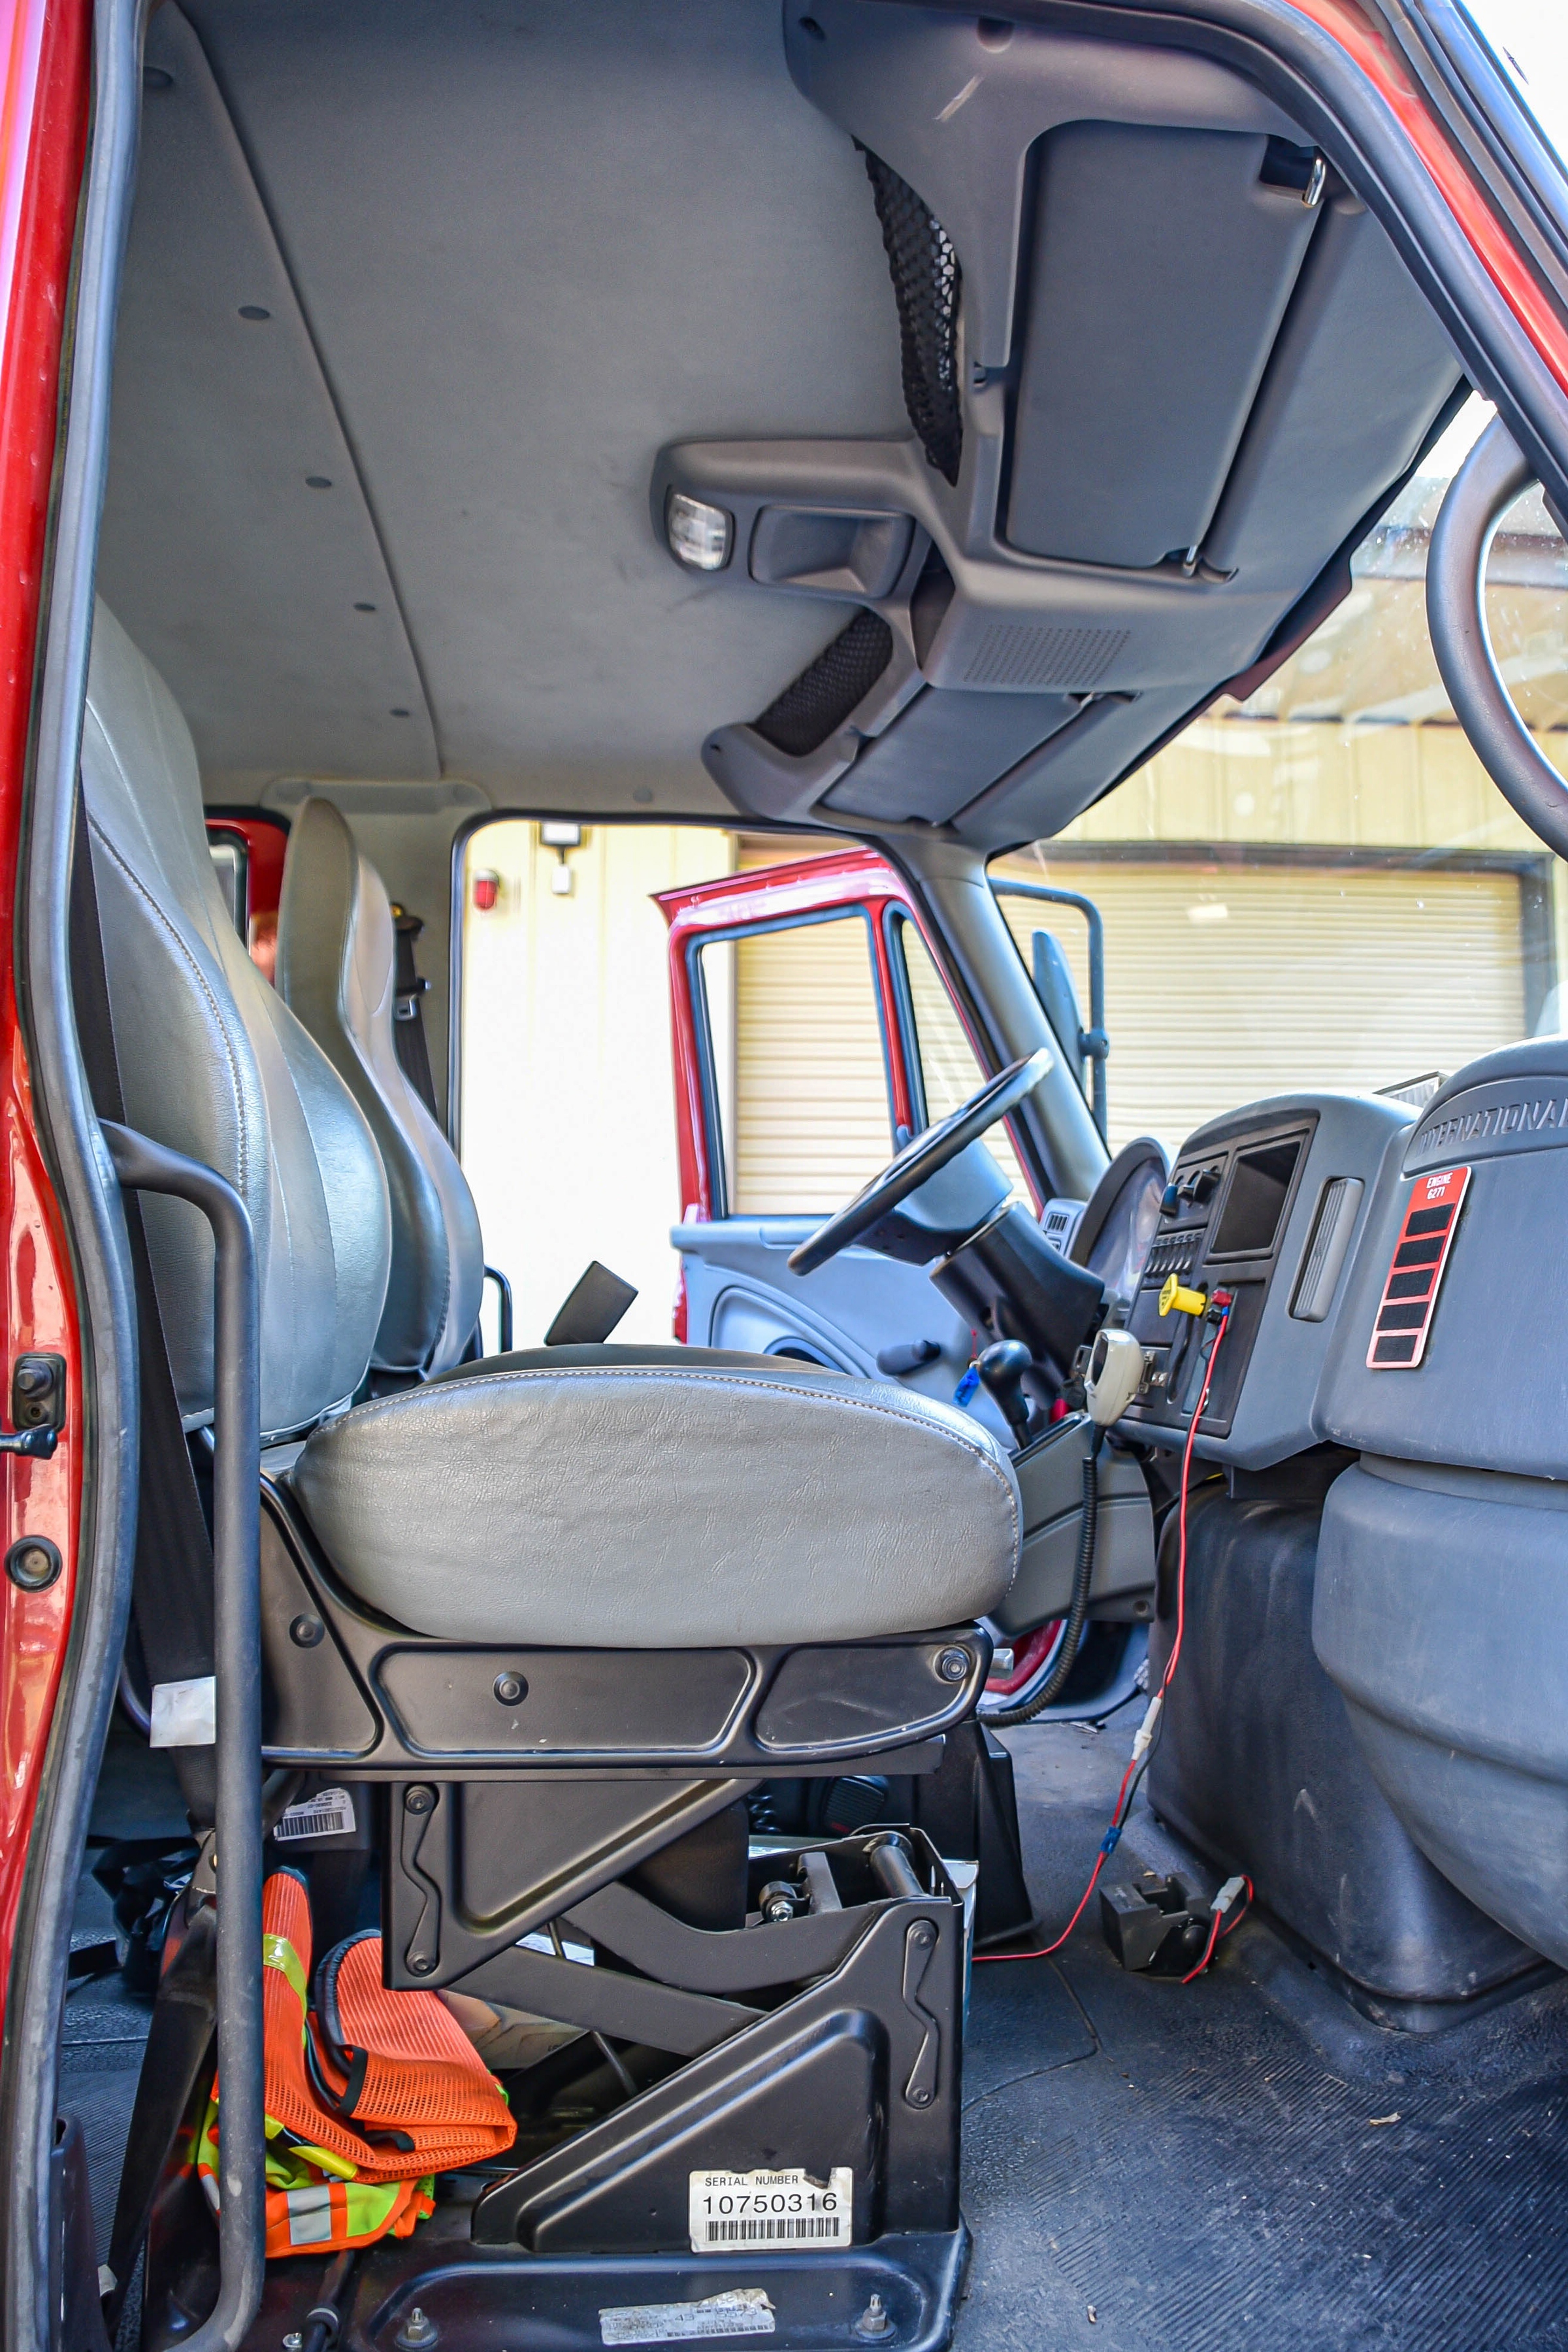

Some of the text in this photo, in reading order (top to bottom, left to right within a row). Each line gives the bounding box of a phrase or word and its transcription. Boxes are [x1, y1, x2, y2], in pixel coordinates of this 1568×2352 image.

[1426, 1172, 1453, 1188] ENGINE
[1427, 1186, 1445, 1200] 6271
[704, 2174, 798, 2187] SERIAL NUMBER
[703, 2192, 837, 2215] 10750316
